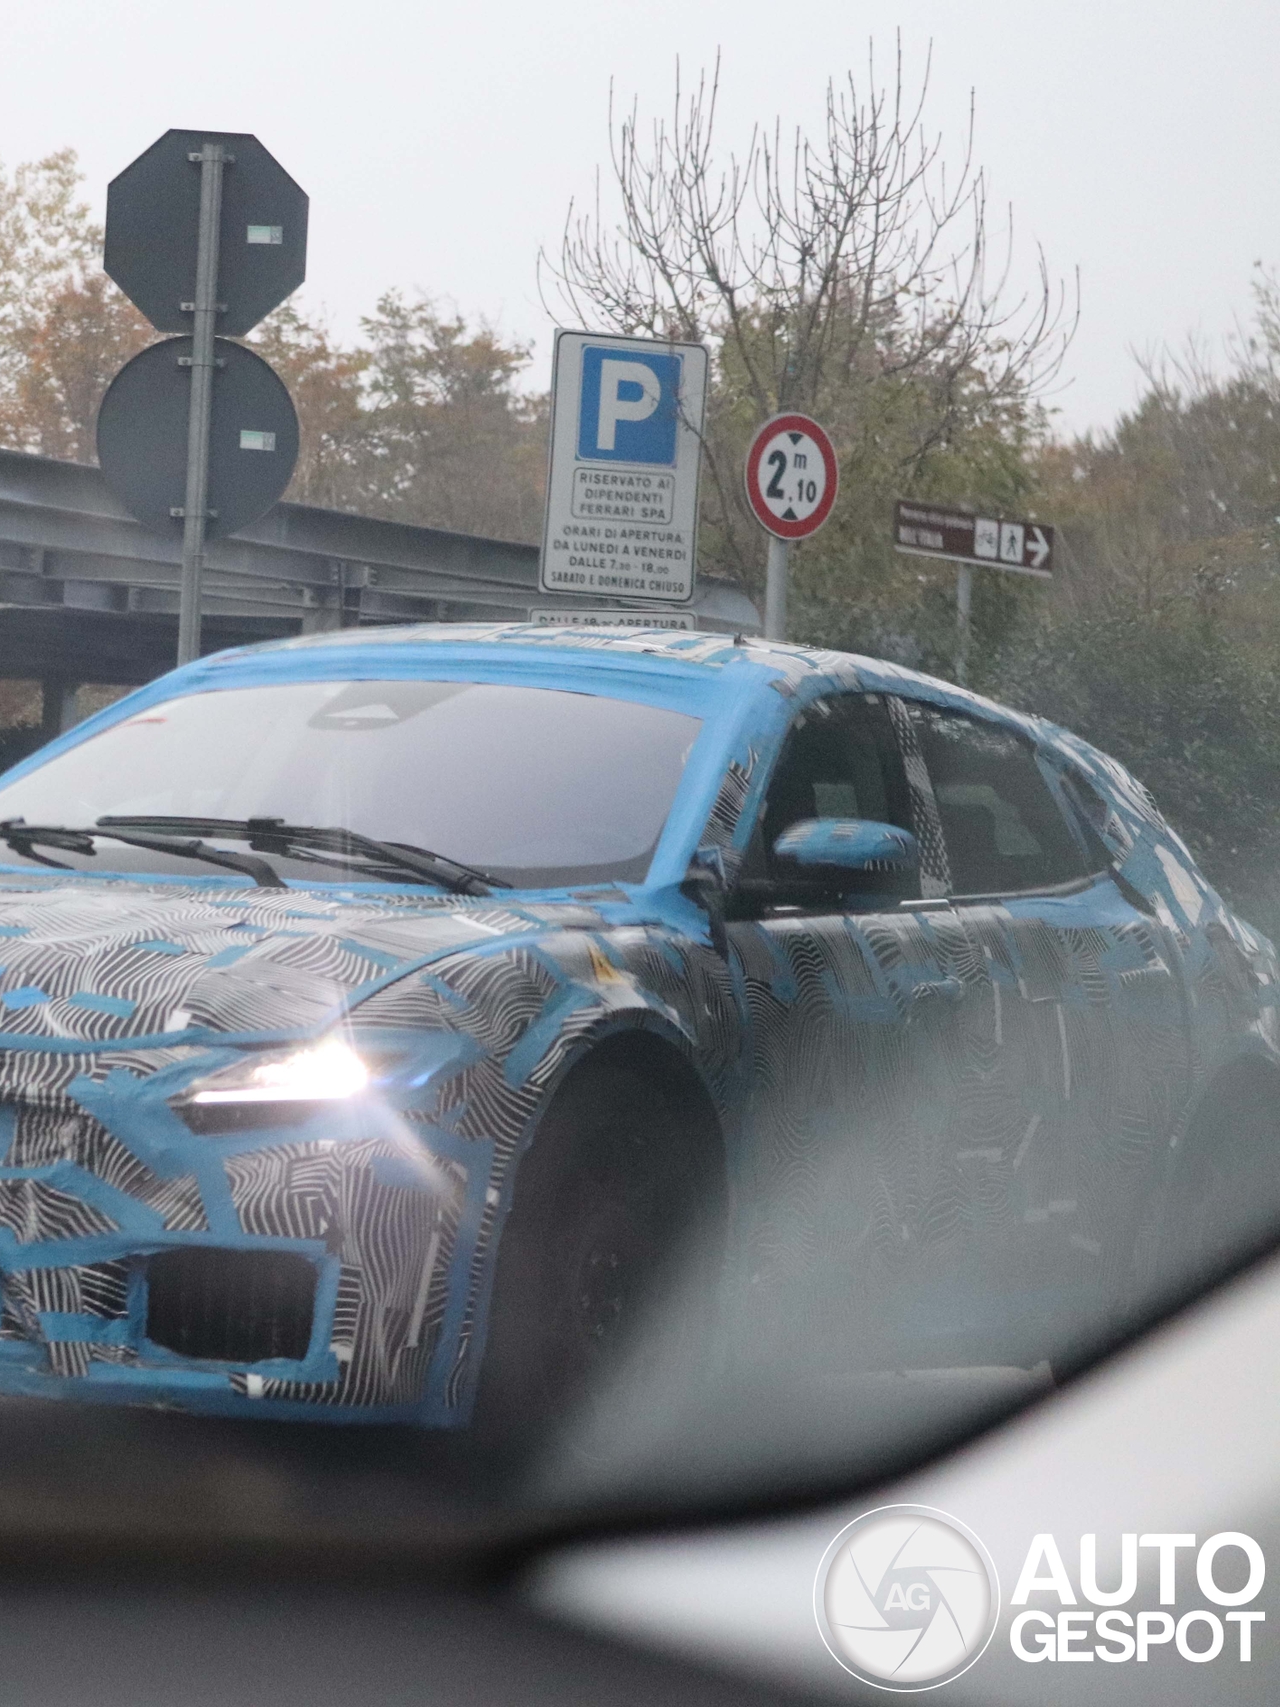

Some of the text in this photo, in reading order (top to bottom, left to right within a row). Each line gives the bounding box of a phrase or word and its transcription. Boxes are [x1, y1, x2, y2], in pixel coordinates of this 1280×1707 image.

[596, 358, 662, 451] P
[580, 472, 670, 490] RISERVATO AI
[584, 488, 663, 504] DIPENDENTI
[579, 503, 666, 520] FERRARI SPA
[562, 524, 601, 538] ORARI
[604, 528, 617, 540] DI
[552, 539, 570, 551] DA
[622, 544, 630, 556] A
[569, 556, 606, 569] DALLE
[550, 571, 685, 593] SABATO E DOMENICA CHIUSO
